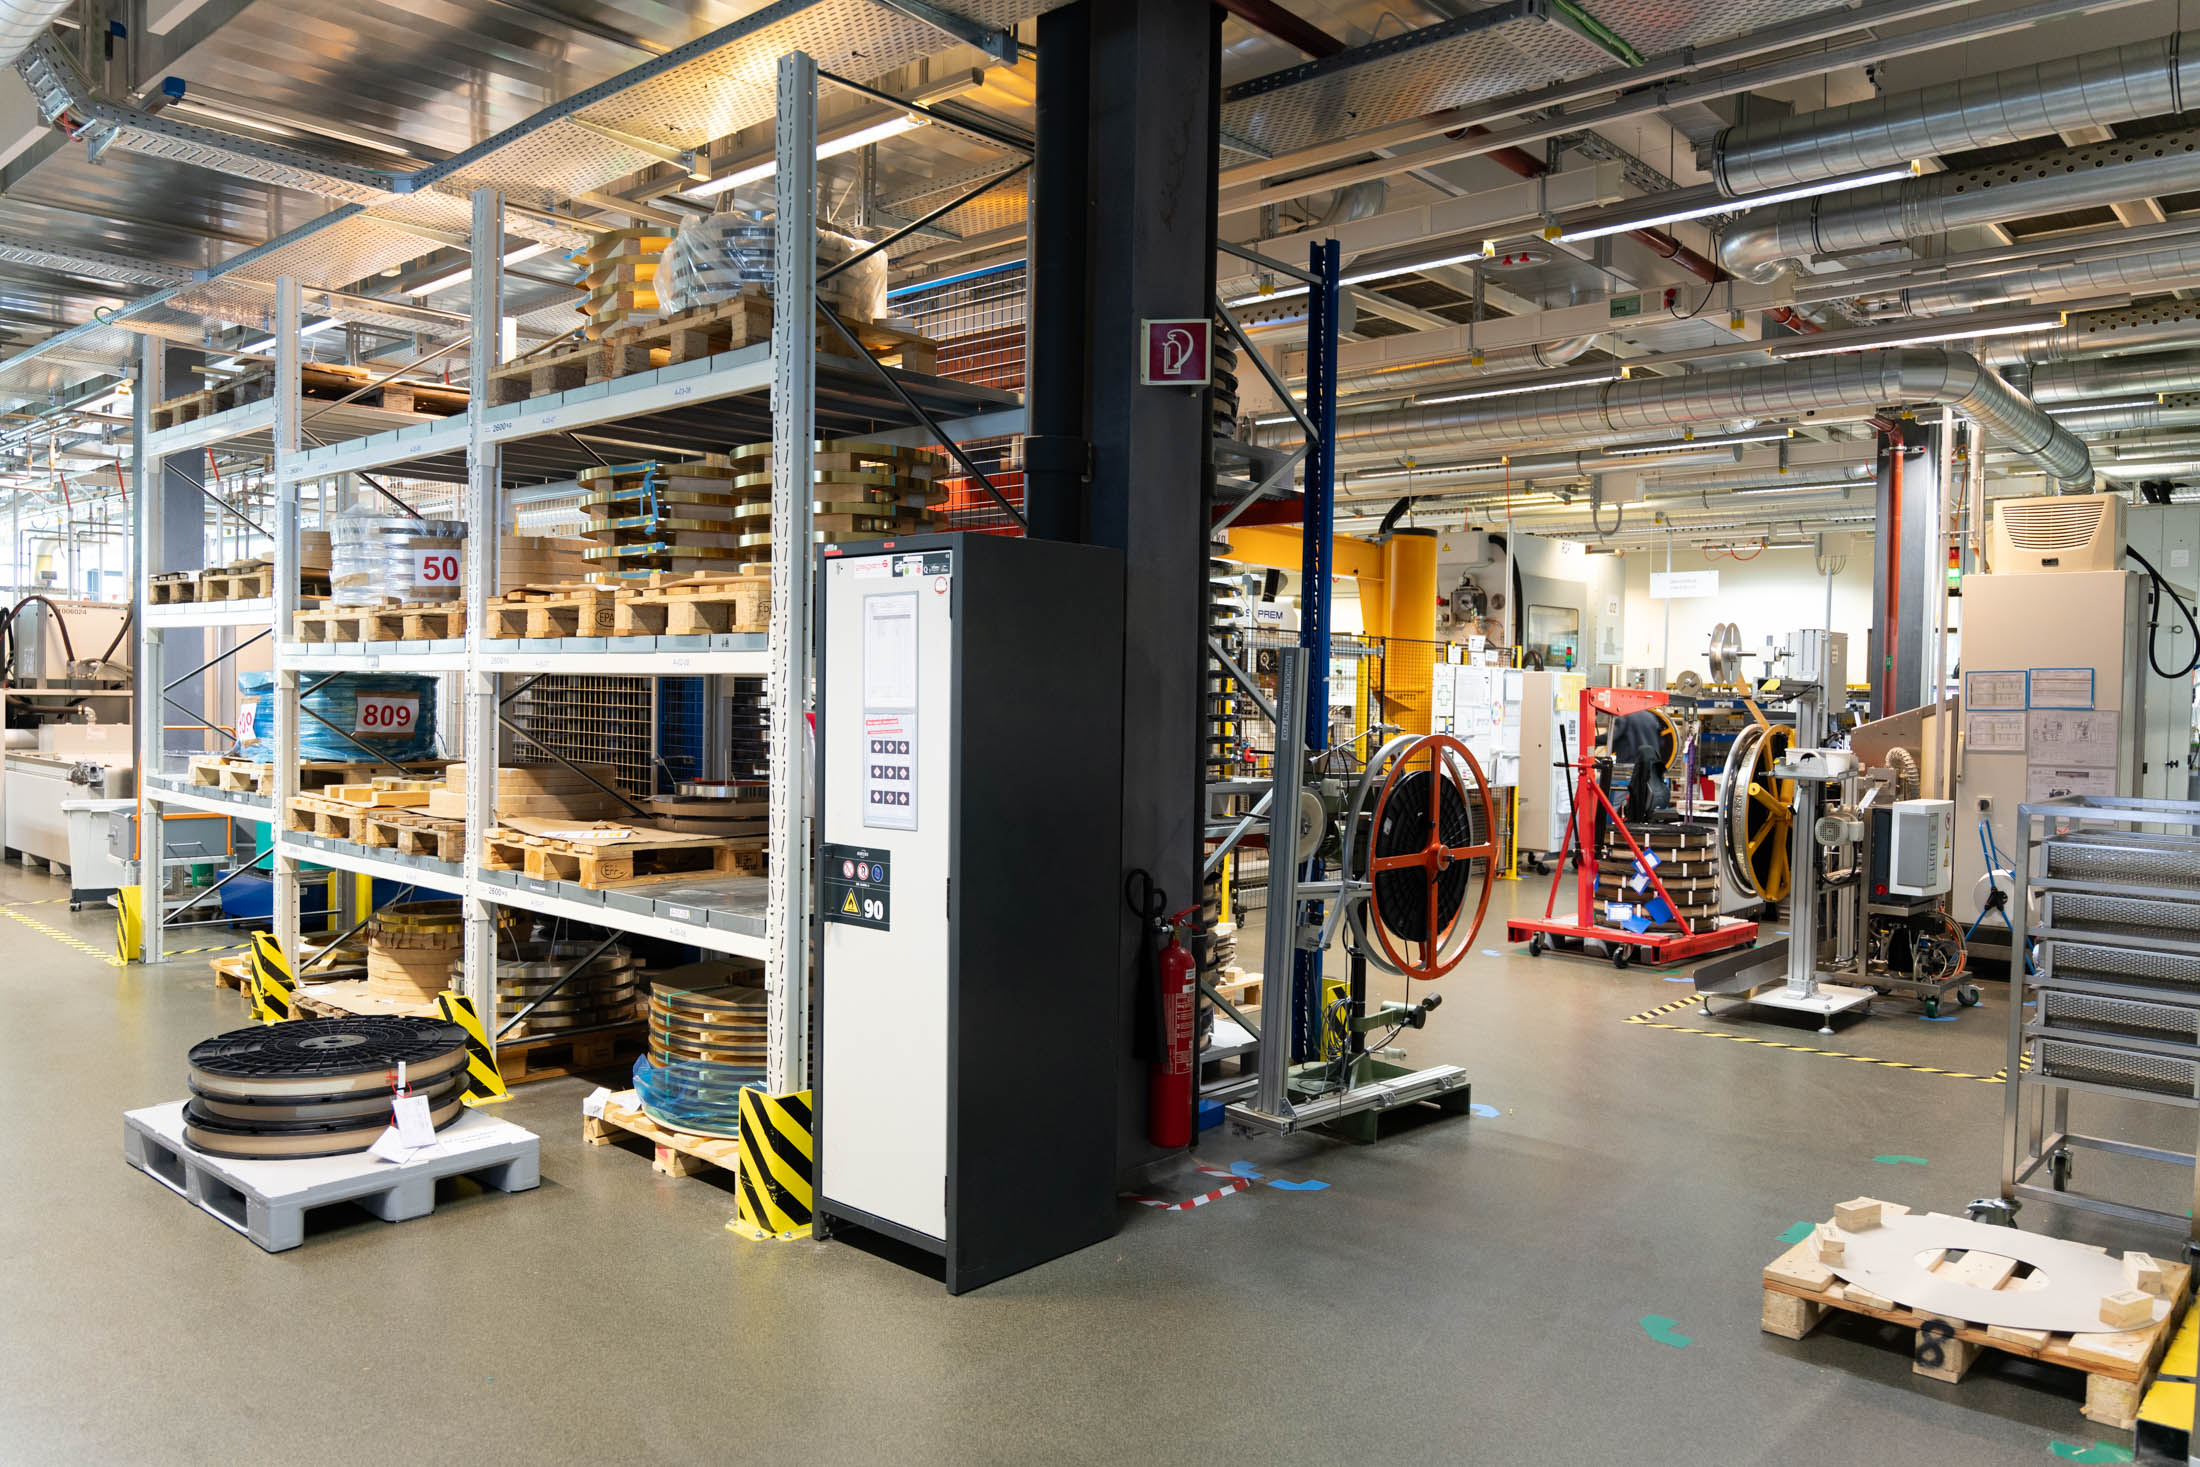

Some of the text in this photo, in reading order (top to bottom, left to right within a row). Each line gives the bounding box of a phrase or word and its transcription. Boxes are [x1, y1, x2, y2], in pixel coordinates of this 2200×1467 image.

[423, 556, 458, 581] 50
[599, 612, 615, 623] EPA
[1246, 608, 1283, 620] SPREM
[363, 704, 411, 727] 809
[864, 898, 884, 920] 90
[1915, 1318, 1955, 1368] 8
